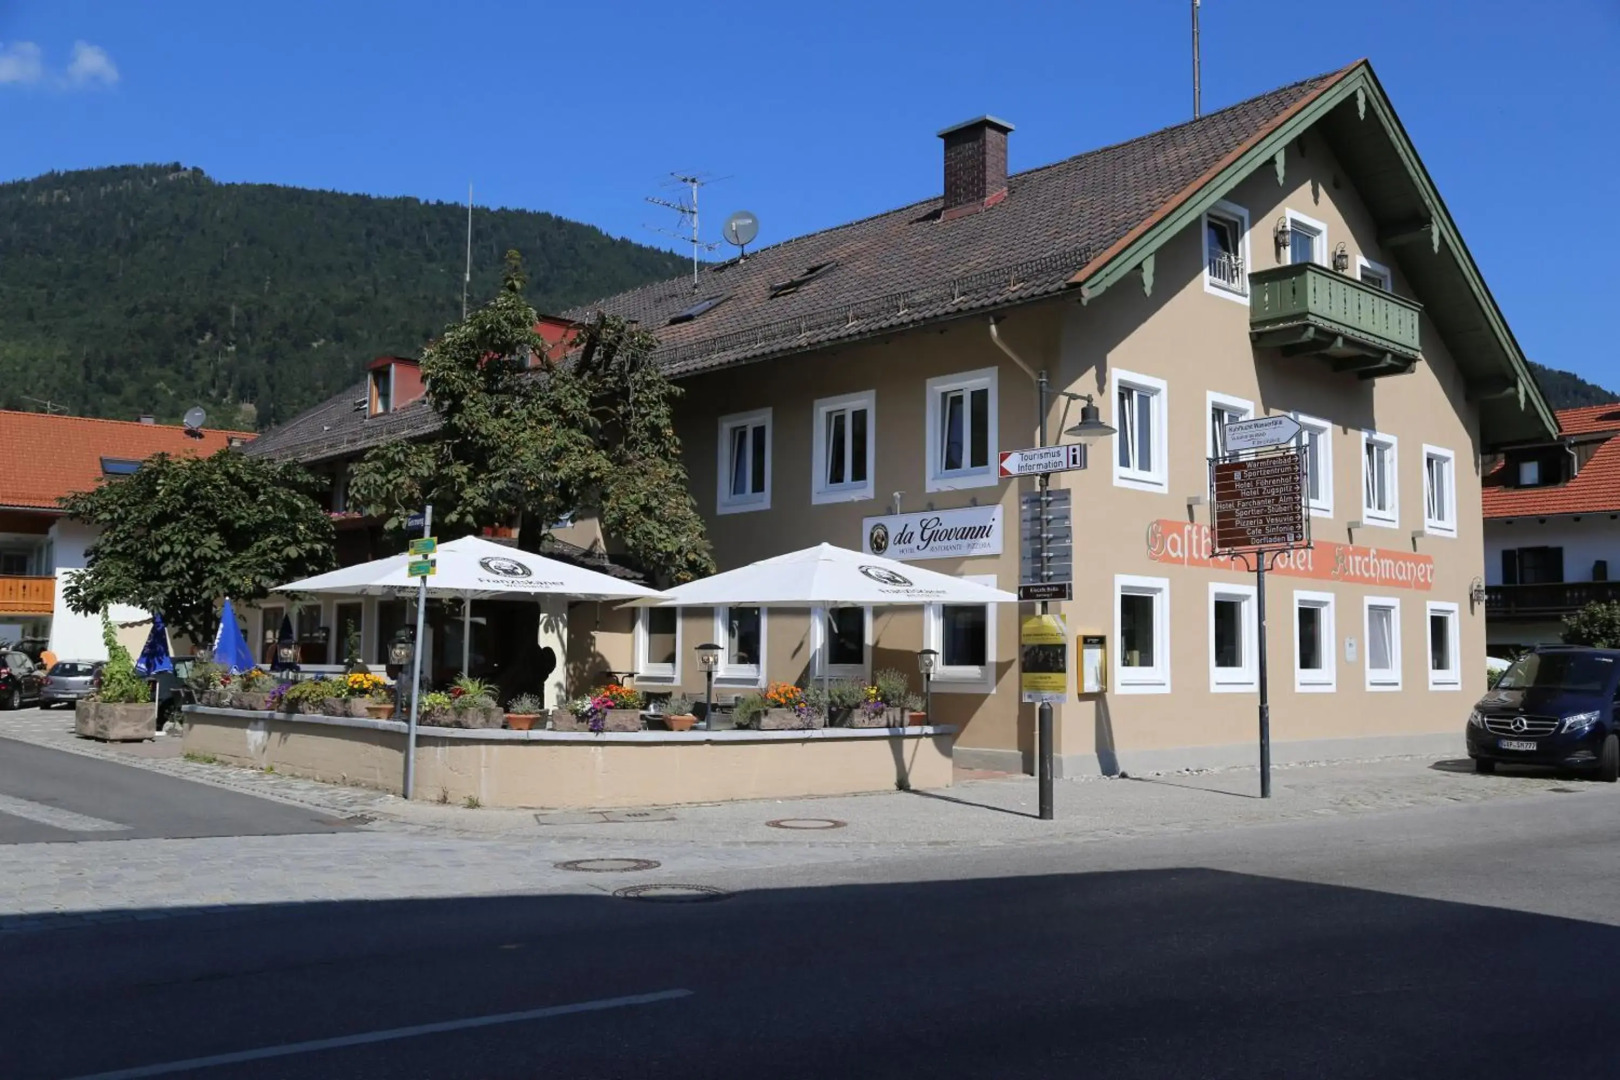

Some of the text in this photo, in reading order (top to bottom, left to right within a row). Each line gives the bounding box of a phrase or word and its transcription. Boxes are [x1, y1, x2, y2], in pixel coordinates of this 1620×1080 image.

[1020, 449, 1061, 462] Tourismus
[1017, 460, 1063, 473] Information
[1246, 456, 1292, 468] Warmfreibad
[1243, 467, 1292, 479] Sportzentrum
[1241, 485, 1293, 497] Hotel Zugspitz
[1216, 495, 1294, 510] Hotel Farchanter Alm
[1235, 515, 1294, 527] Pizzeria Vesuvio
[892, 523, 915, 545] da
[917, 516, 995, 551] Giovanni
[1265, 525, 1294, 533] Sinfonie
[1251, 535, 1286, 545] Dorfladen
